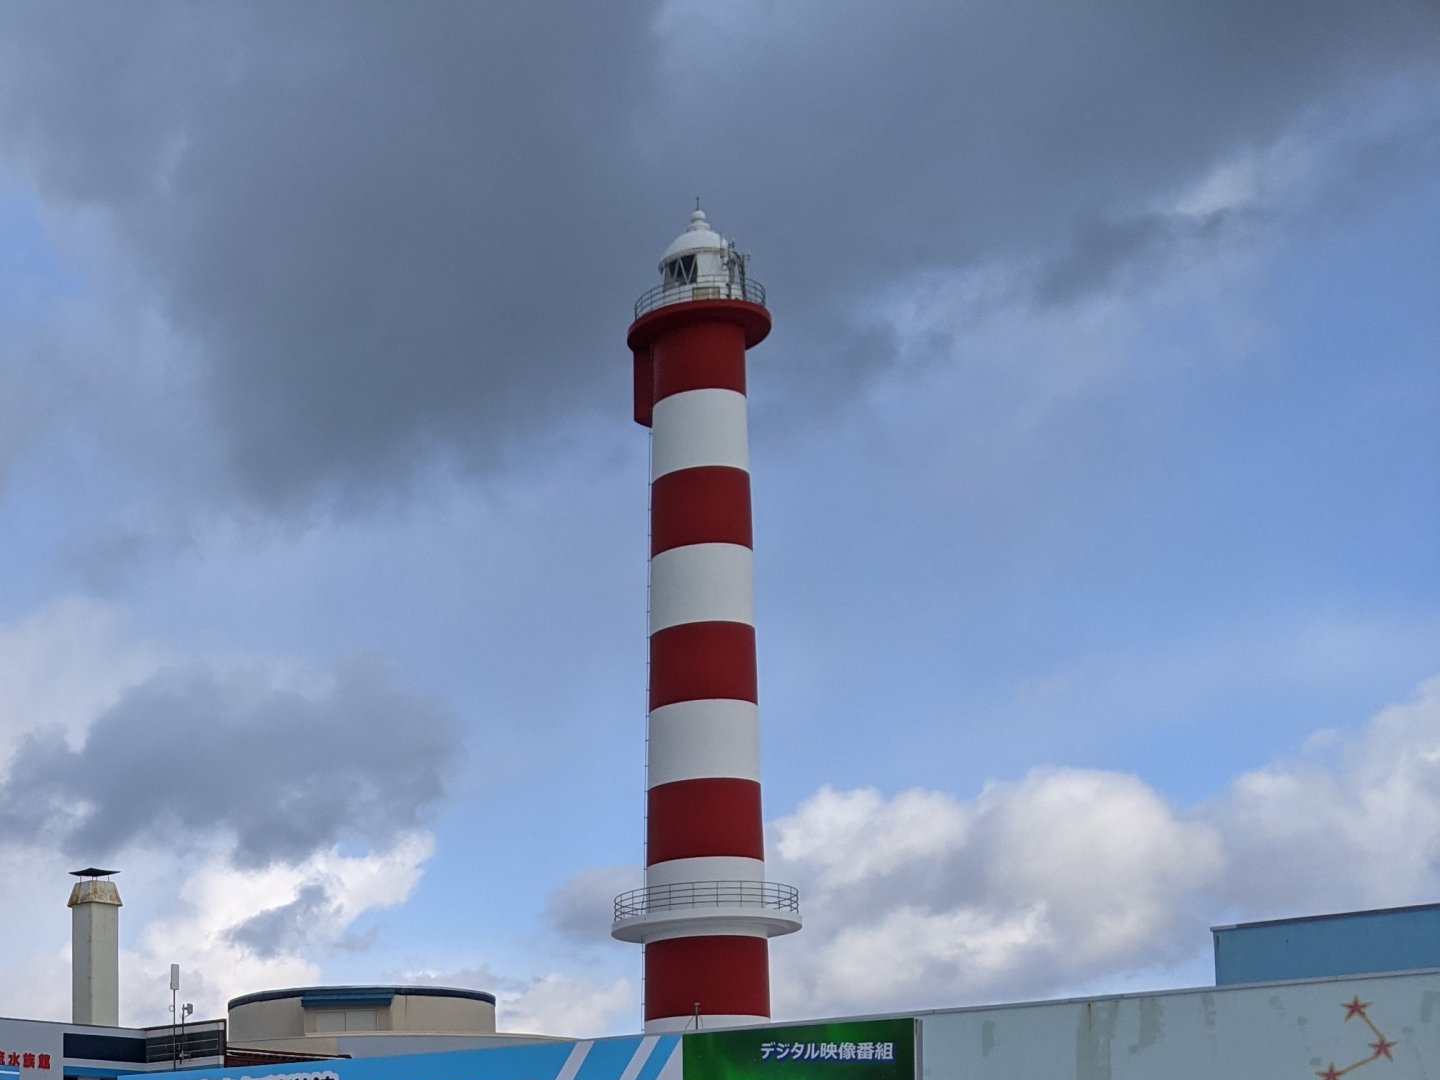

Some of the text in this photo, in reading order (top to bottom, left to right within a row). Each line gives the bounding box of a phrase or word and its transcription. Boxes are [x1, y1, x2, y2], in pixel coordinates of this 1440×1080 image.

[760, 1041, 893, 1060] デジタル映像番組
